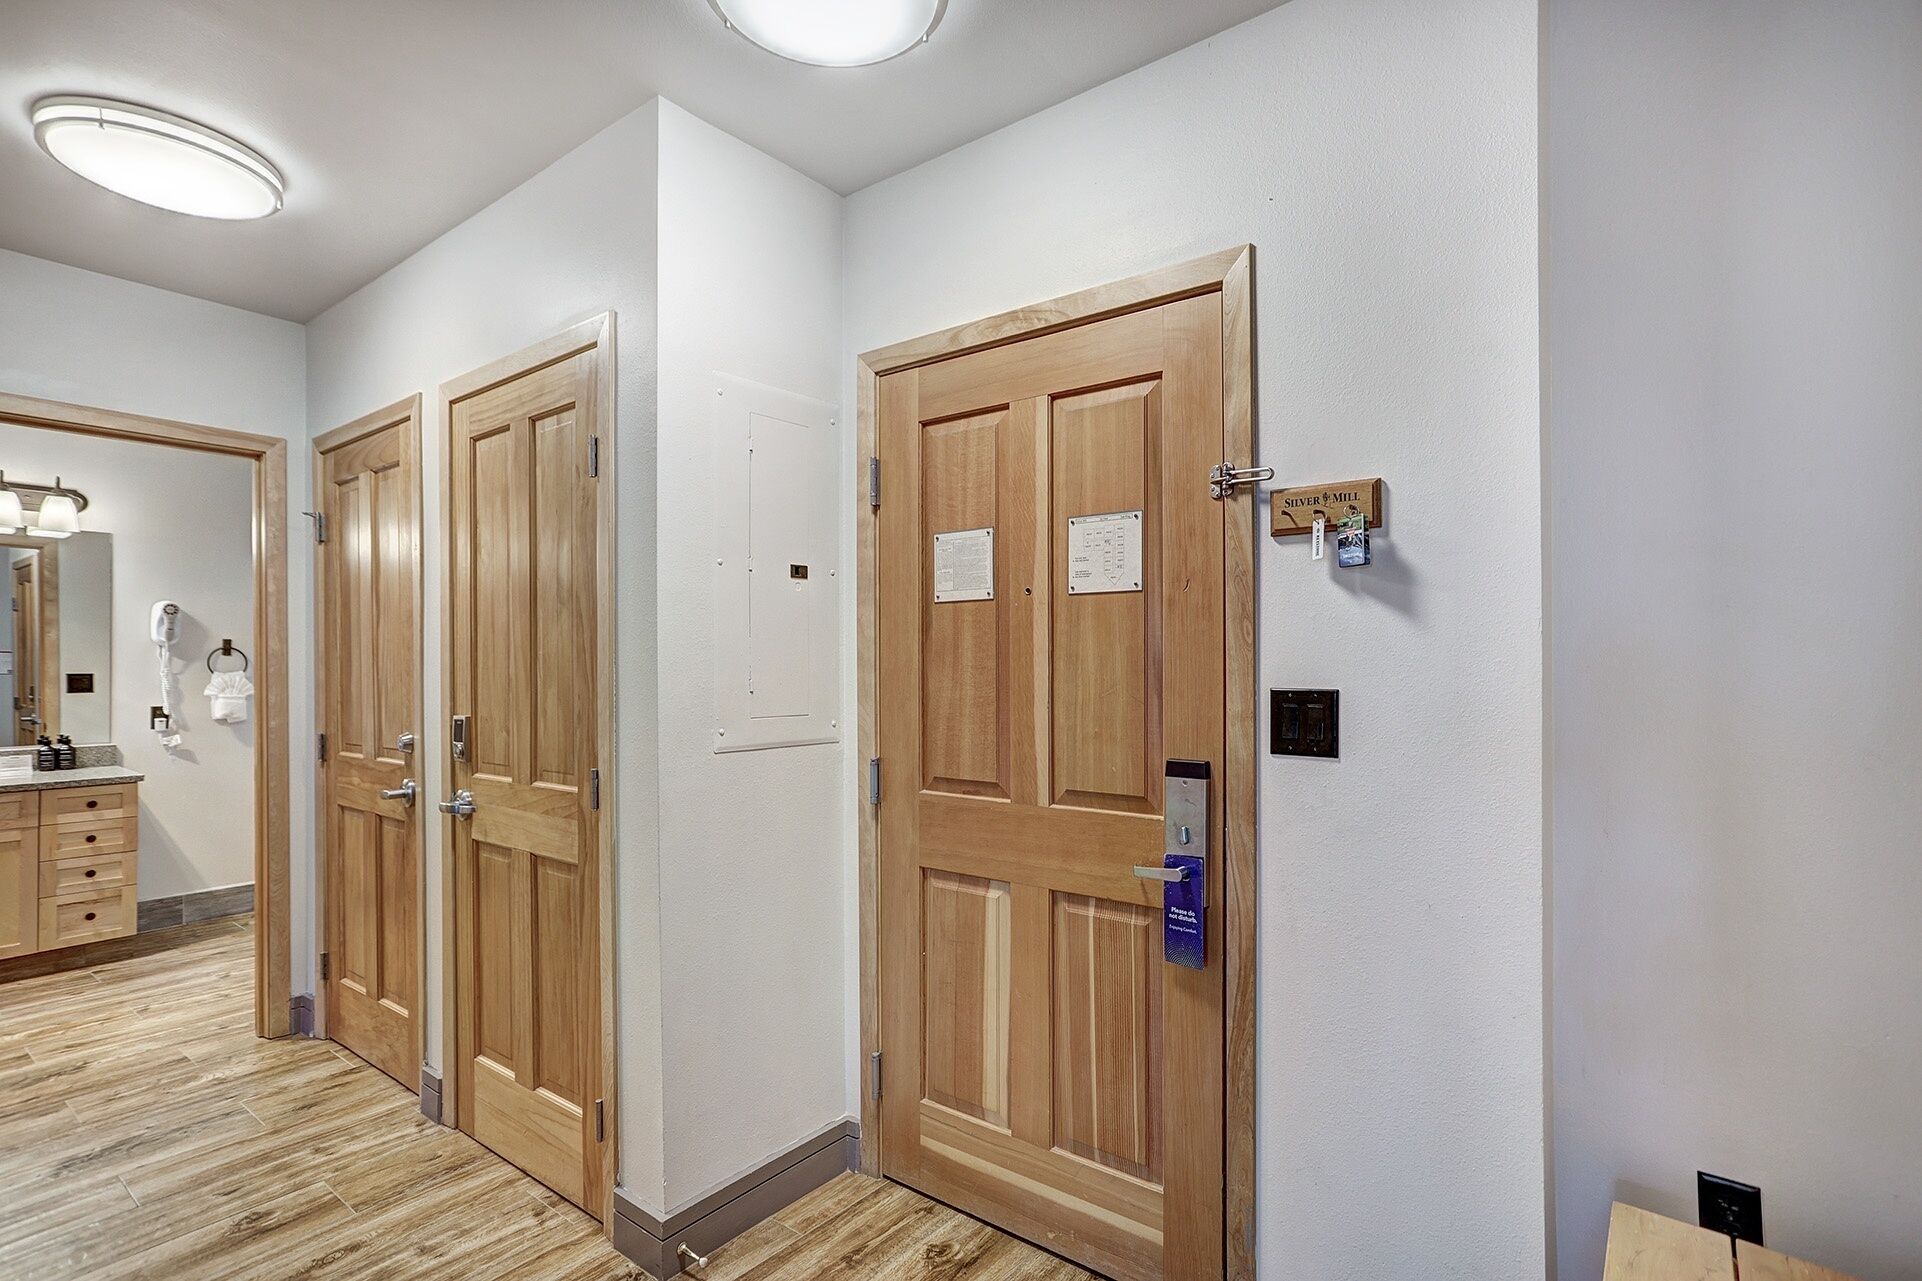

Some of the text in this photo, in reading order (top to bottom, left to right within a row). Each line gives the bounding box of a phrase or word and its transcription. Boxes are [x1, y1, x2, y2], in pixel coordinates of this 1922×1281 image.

[1284, 492, 1360, 508] SILVER MILL
[1171, 906, 1187, 915] Please
